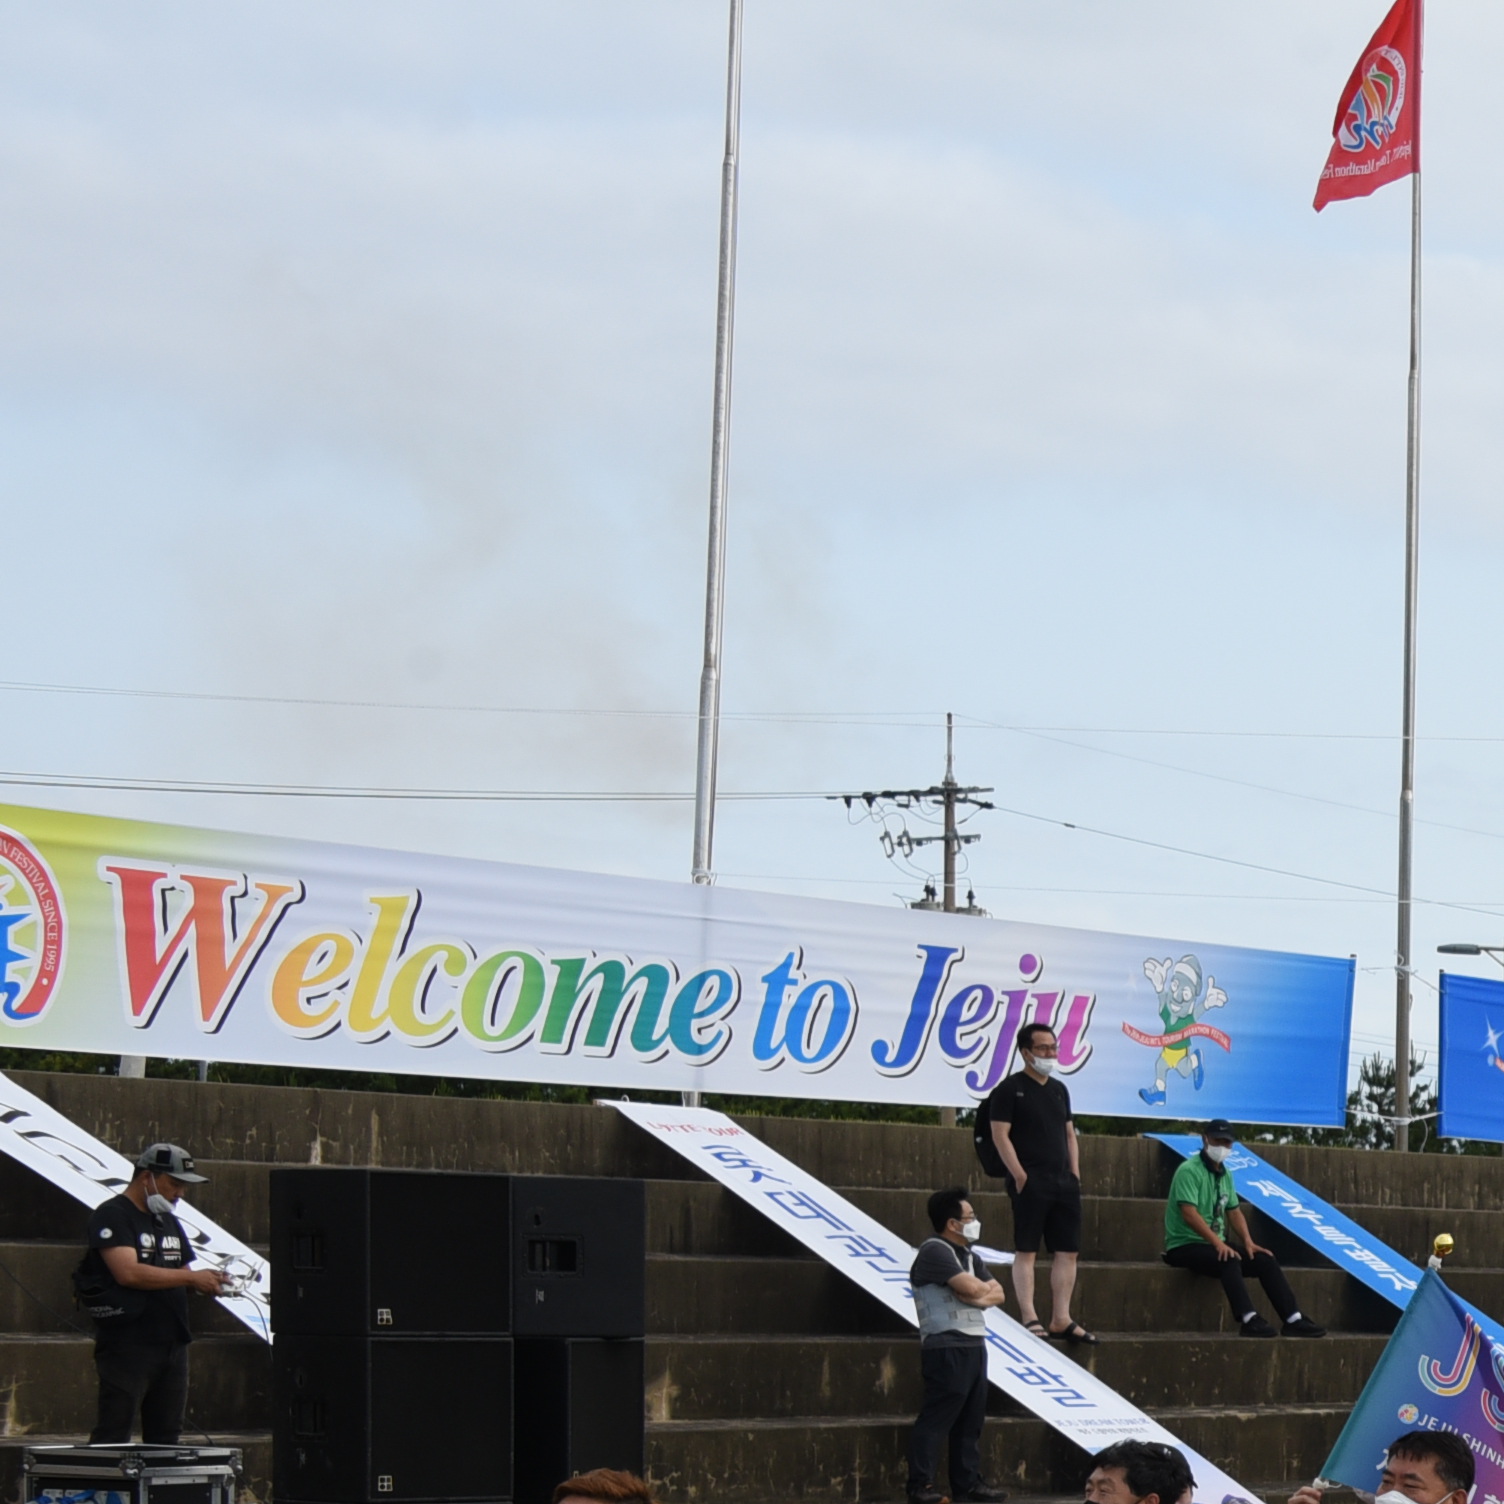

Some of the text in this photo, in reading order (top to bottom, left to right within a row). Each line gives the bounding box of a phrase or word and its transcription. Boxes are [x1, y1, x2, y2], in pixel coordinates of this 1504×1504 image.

[104, 862, 1093, 1097] Welcome to Jeju
